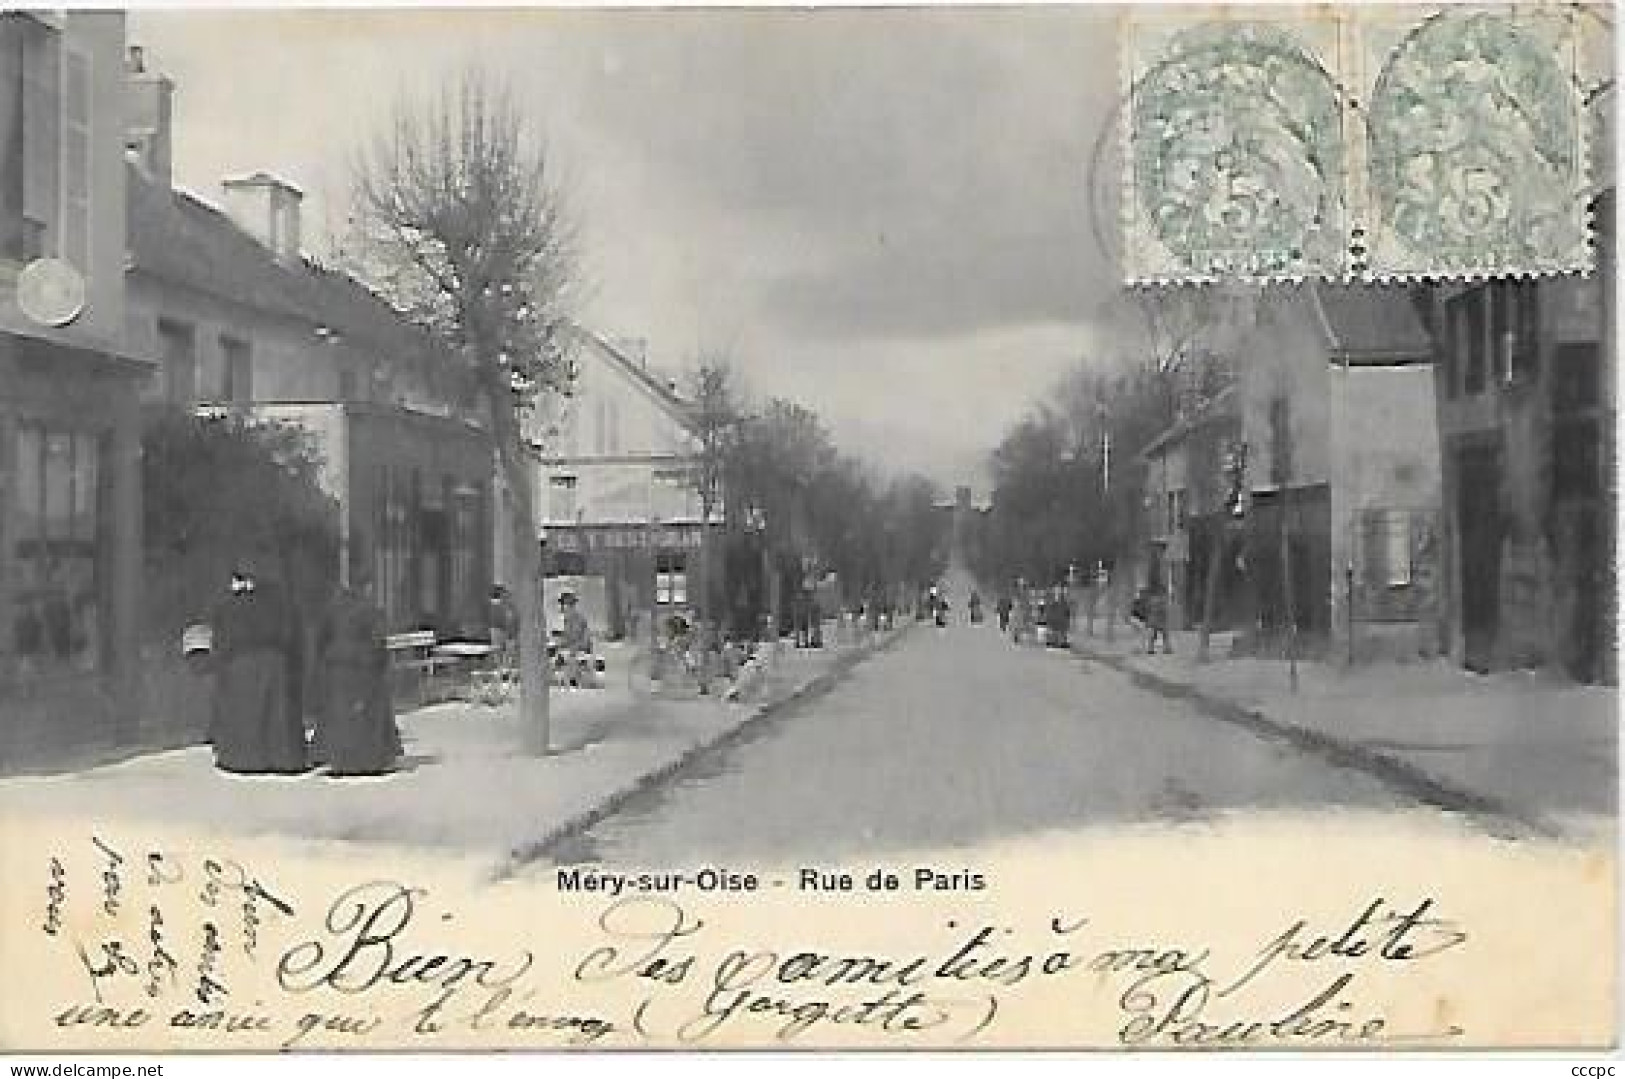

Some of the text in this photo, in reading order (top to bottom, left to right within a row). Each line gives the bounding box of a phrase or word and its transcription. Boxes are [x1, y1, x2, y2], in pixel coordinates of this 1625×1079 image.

[557, 868, 759, 895] Méry-sur-Oise
[799, 868, 853, 891] Rue
[865, 868, 900, 891] de
[914, 868, 987, 891] Paris
[276, 880, 533, 993] Bien
[1217, 897, 1466, 998] petite
